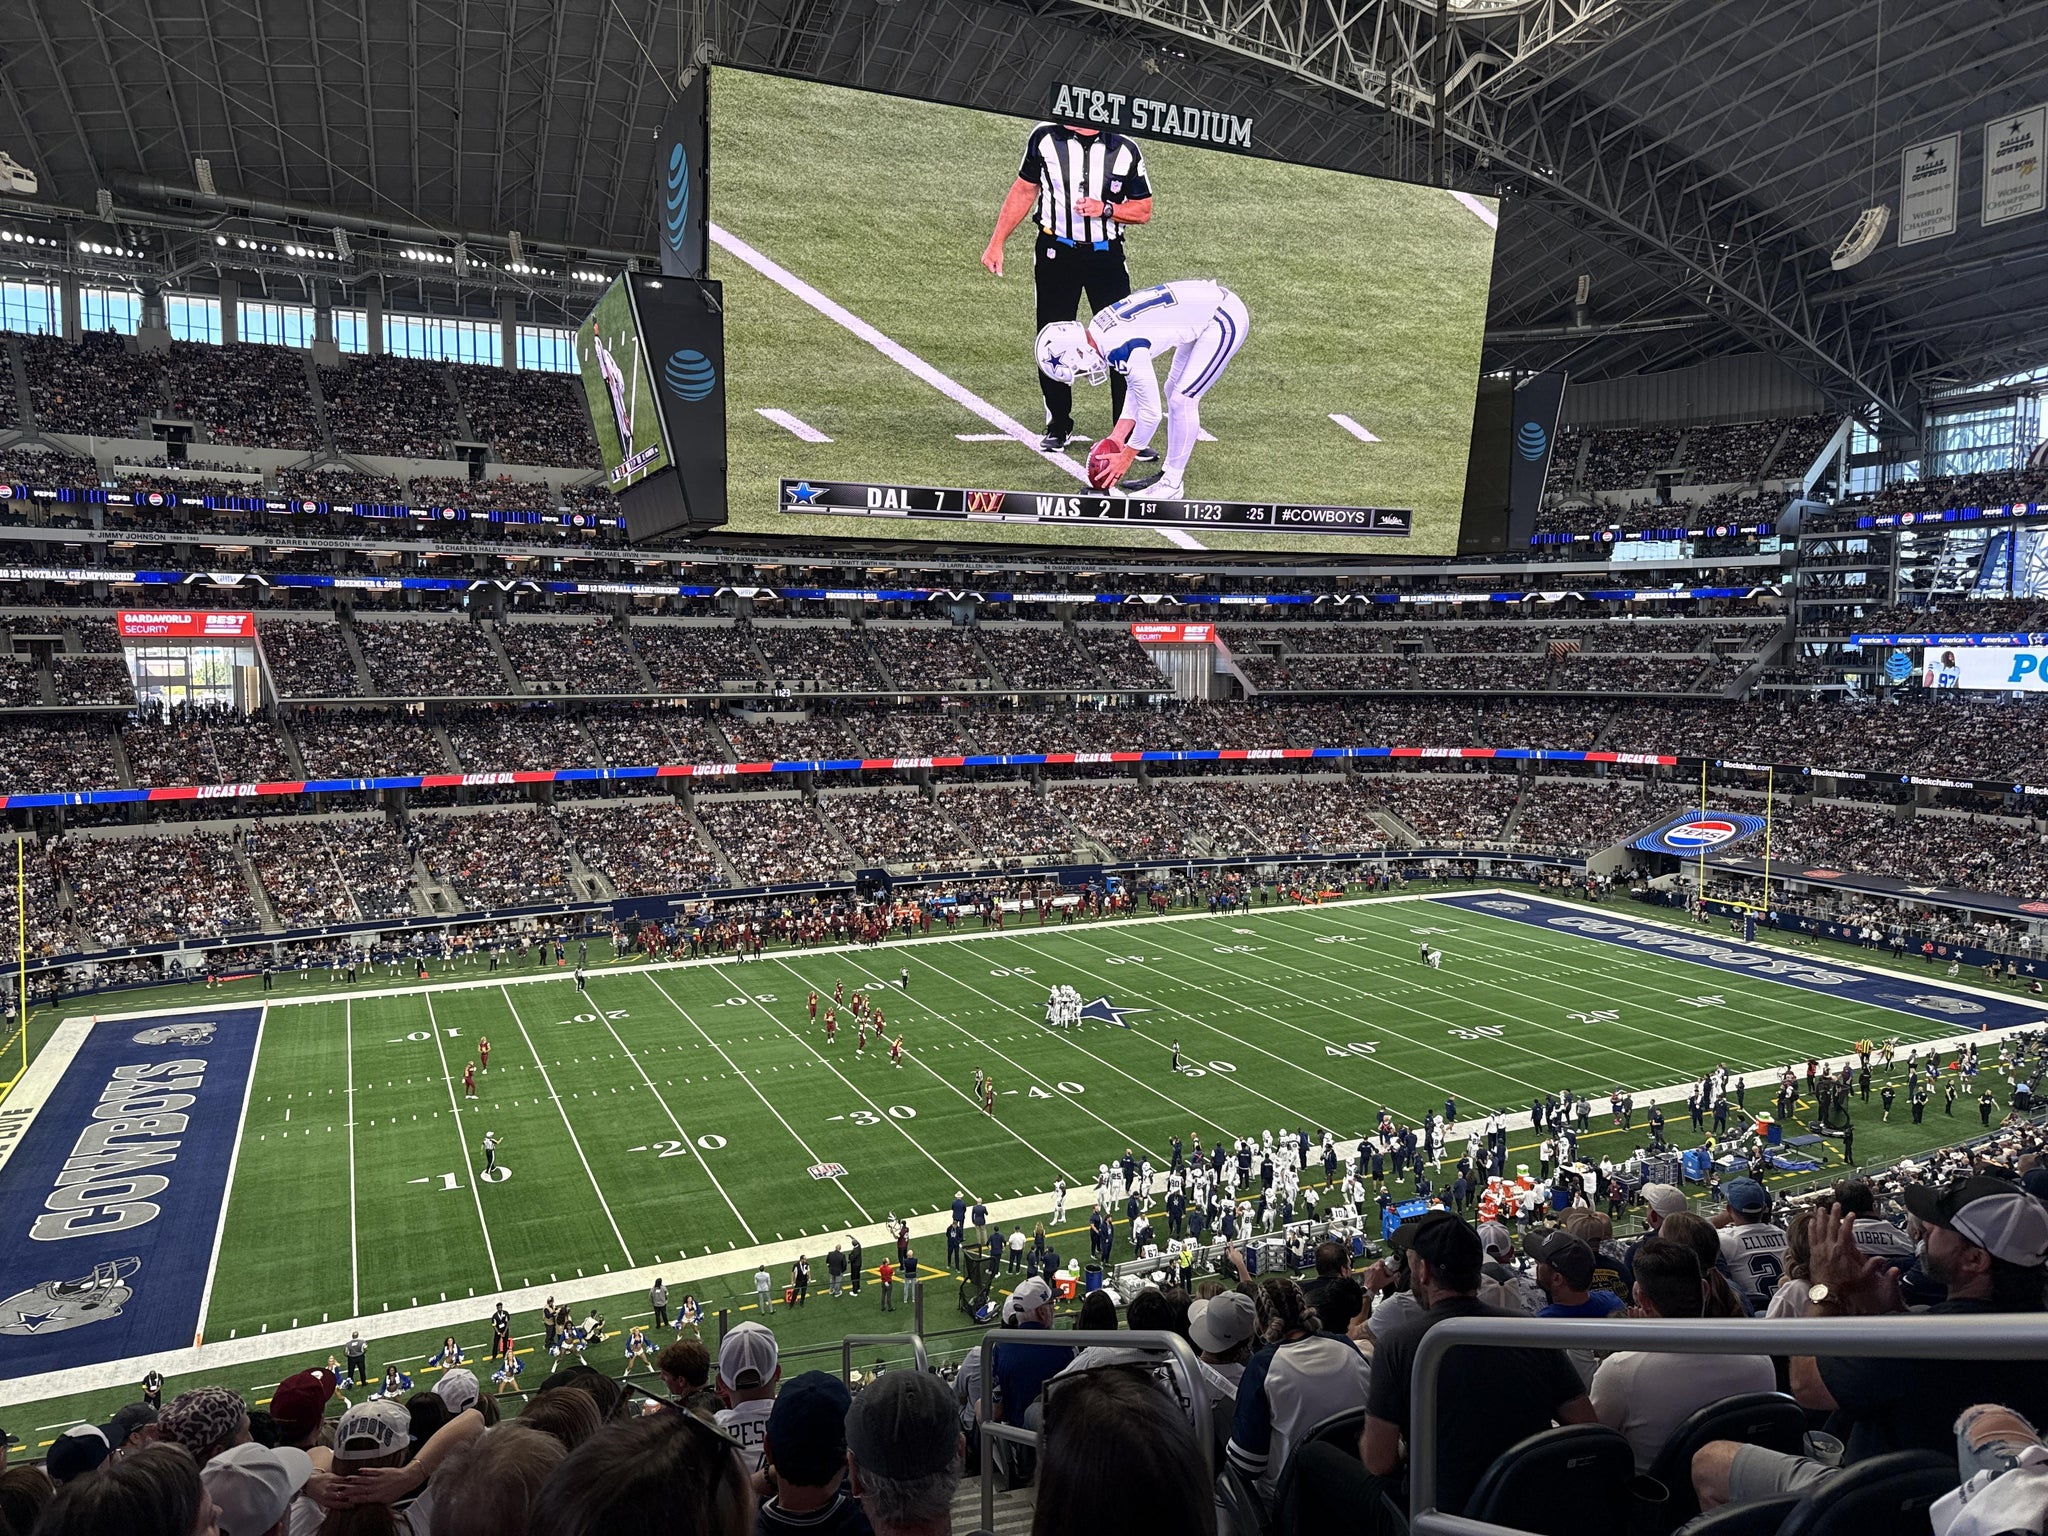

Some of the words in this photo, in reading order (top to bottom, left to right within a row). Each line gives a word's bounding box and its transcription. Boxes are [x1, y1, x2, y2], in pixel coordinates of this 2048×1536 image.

[1052, 84, 1126, 125] AT&T
[1131, 98, 1253, 148] STADIUM
[2000, 132, 2031, 149] DALLAS
[1915, 159, 1945, 173] DALLAS
[1912, 207, 1943, 220] WORLD
[867, 487, 912, 510] DAL
[934, 491, 945, 511] 7
[1036, 496, 1081, 517] WAS
[1098, 500, 1110, 519] 2
[1139, 502, 1157, 517] 1ST
[1183, 503, 1222, 521] 11:23
[1245, 506, 1265, 520] :25
[1281, 508, 1365, 524] #COWBOYS
[1923, 513, 1942, 521] PEPSI
[1983, 508, 2003, 516] PEPSI
[1876, 517, 1894, 525] PEPSI
[97, 532, 124, 540] JIMMY
[125, 533, 166, 541] JOHNSON
[0, 570, 9, 578] IG
[10, 570, 20, 578] 12
[22, 571, 68, 580] FOOTBALL
[69, 572, 136, 581] CHAMPIONSHIP
[334, 580, 376, 588] DECEMBER
[124, 614, 192, 623] GARDAWORLD
[206, 616, 247, 624] BEST
[125, 625, 168, 634] SECURITY
[1858, 636, 1884, 644] American
[1938, 636, 1966, 644] American
[1981, 636, 2011, 644] American
[1938, 673, 1957, 688] 97
[1074, 753, 1099, 763] LUCAS
[1100, 752, 1113, 762] OIL
[1246, 750, 1270, 759] LUCAS
[1270, 750, 1284, 759] OIL
[1420, 748, 1446, 758] LUCAS
[1446, 748, 1463, 758] OIL
[1616, 753, 1642, 763] LUCAS
[1643, 754, 1659, 764] OIL
[892, 758, 919, 768] LUCAS
[920, 757, 934, 768] OIL
[1723, 761, 1772, 770] Blockchain.com
[692, 764, 722, 776] LUCAS
[723, 764, 738, 774] OIL
[1810, 768, 1866, 780] Blockchain.com
[462, 772, 496, 786] LUCAS
[498, 772, 516, 784] OIL
[1910, 776, 1973, 789] Blockchain.com
[196, 784, 236, 799] LUCAS
[238, 784, 259, 797] OIL
[2024, 786, 2048, 796] Block
[1675, 828, 1726, 840] PEPSI
[1547, 916, 1867, 985] COWBOYS
[1104, 955, 1145, 966] 40
[1676, 995, 1726, 1008] 10
[573, 1009, 631, 1024] 20
[1566, 1010, 1620, 1024] 20
[406, 1027, 464, 1042] 10
[1448, 1025, 1504, 1040] 30
[1324, 1042, 1376, 1058] 40
[1028, 1081, 1086, 1100] 40
[849, 1105, 918, 1126] 30
[28, 1059, 208, 1242] COWBOYS
[652, 1134, 728, 1159] 20
[436, 1166, 513, 1192] 10
[1334, 1209, 1343, 1218] 10
[1742, 1232, 1788, 1250] ELLIOTT
[1855, 1231, 1894, 1246] UBREY
[1060, 1283, 1070, 1294] G
[338, 1417, 394, 1447] COWBOYS
